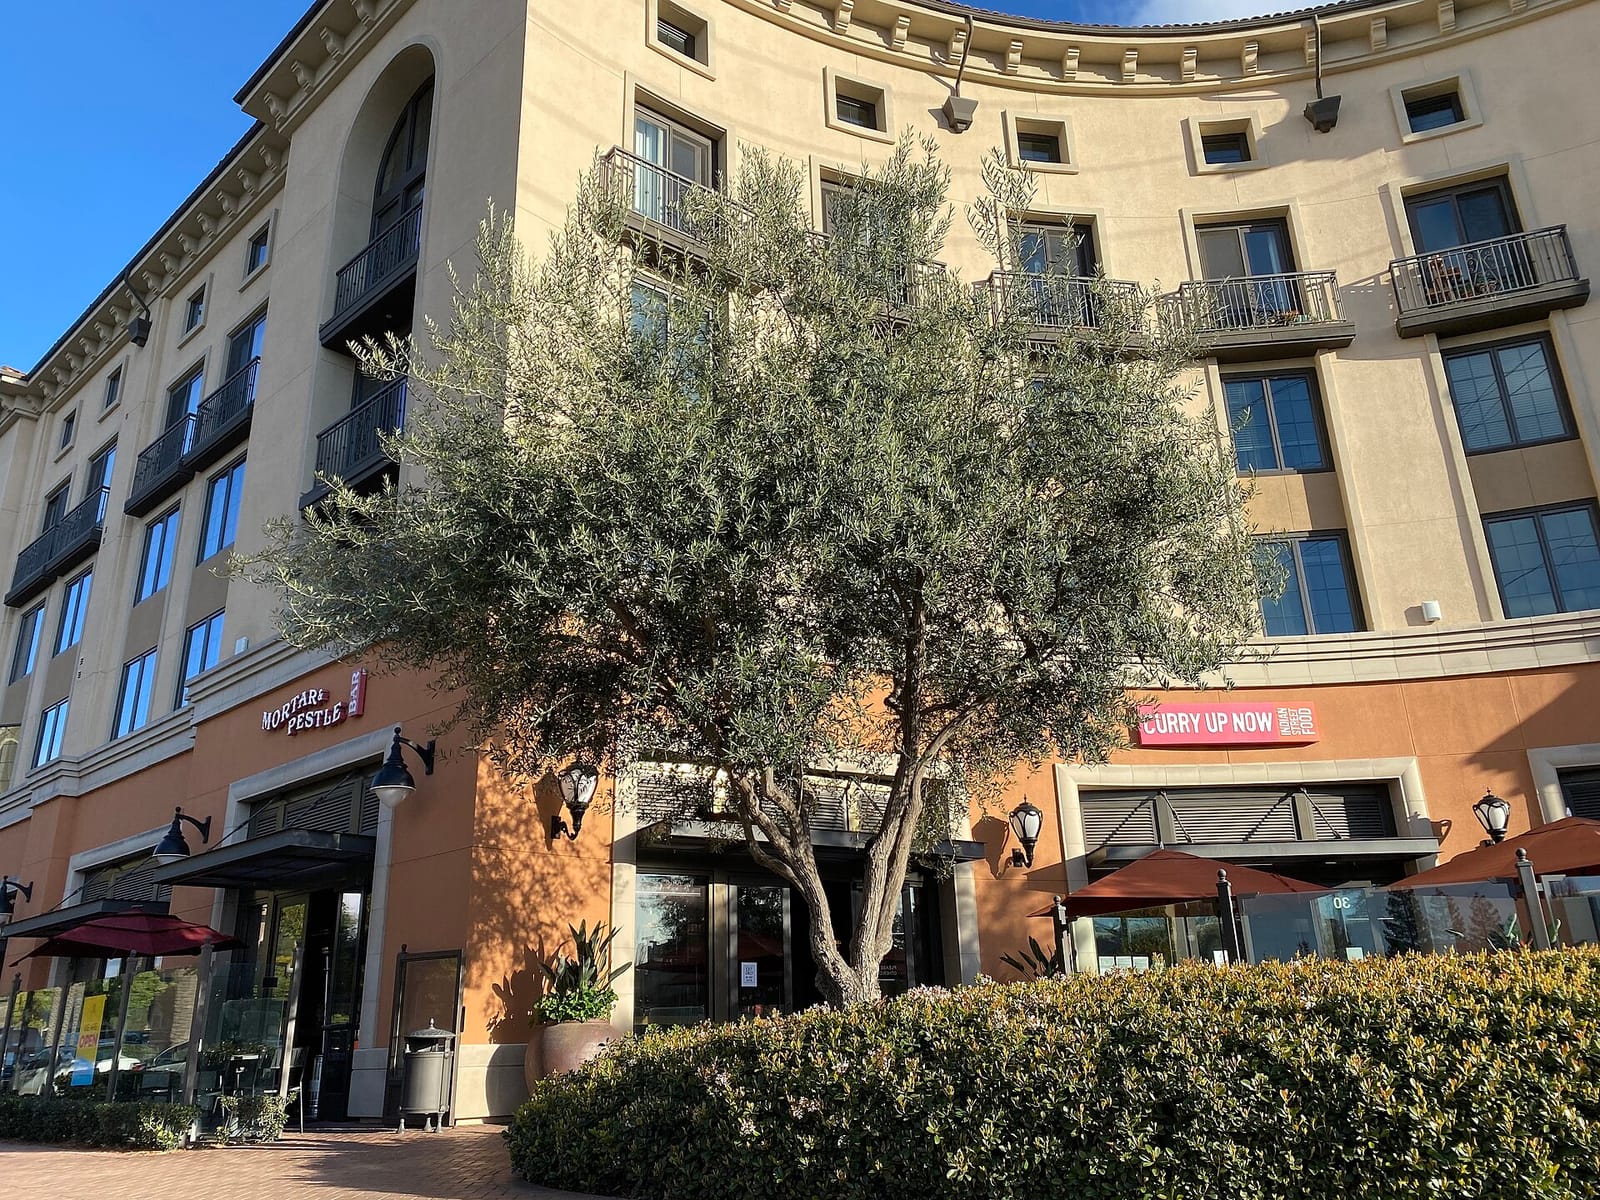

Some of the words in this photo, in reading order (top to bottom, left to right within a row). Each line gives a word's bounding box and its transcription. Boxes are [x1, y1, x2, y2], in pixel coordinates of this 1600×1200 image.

[348, 671, 360, 714] BAR
[287, 702, 342, 735] PESTLE
[1143, 711, 1201, 734] CURRY
[1205, 711, 1229, 733] UP
[1232, 711, 1273, 733] NOW
[1277, 707, 1292, 736] INDIAN
[1289, 707, 1302, 736] STREET
[1298, 707, 1317, 735] FOOD
